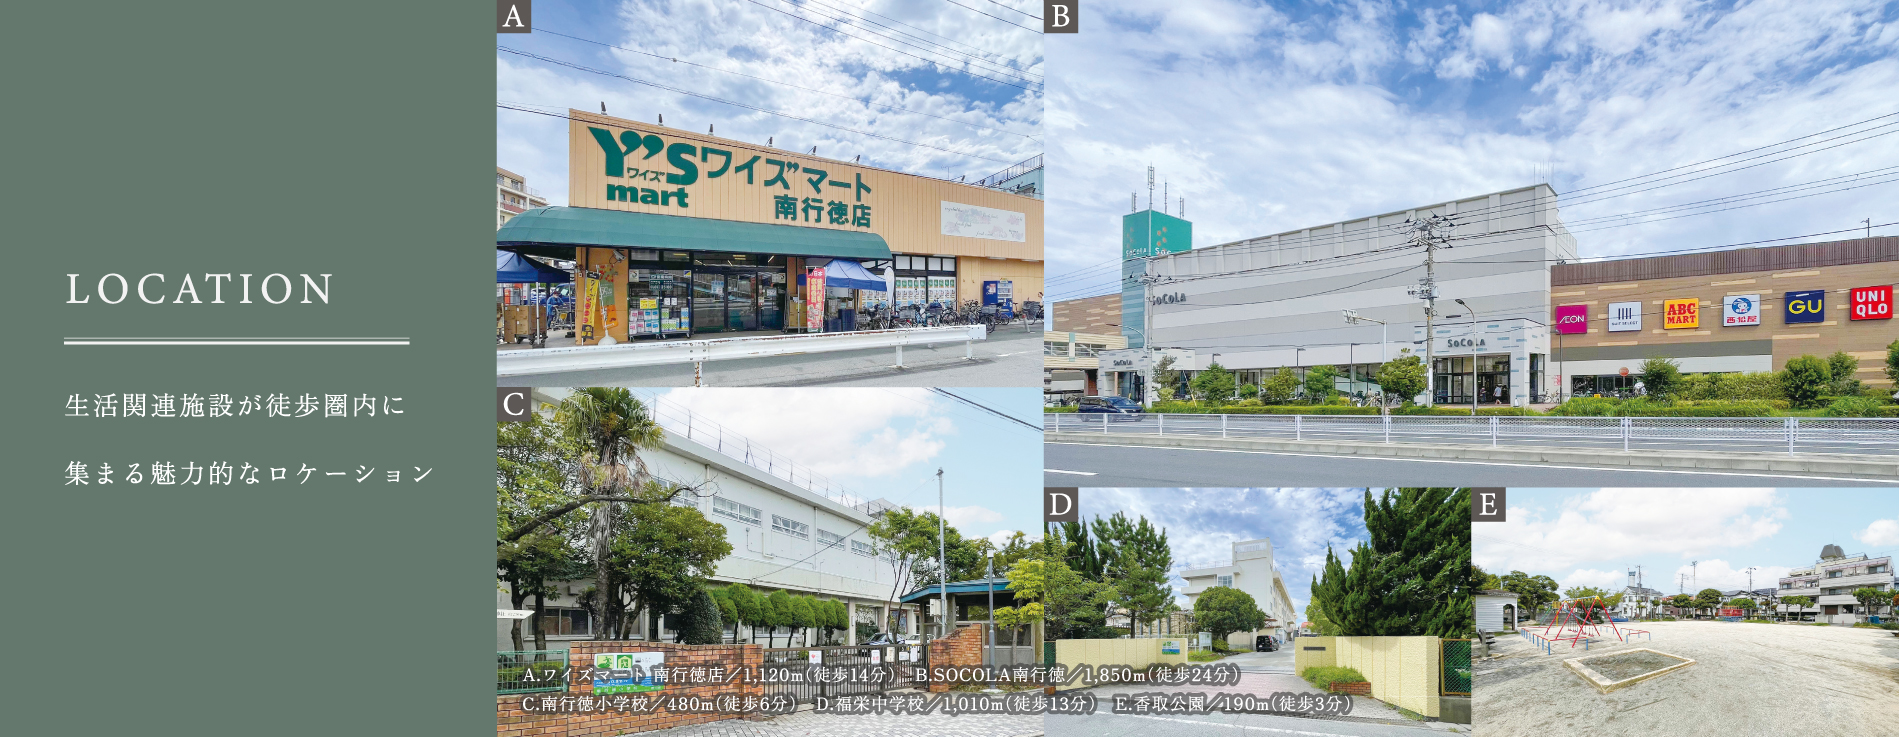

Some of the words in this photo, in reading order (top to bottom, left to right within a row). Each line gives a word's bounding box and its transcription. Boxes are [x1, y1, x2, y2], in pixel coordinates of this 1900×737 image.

[626, 166, 665, 183] ワイズ
[701, 145, 872, 202] ワイズマート
[606, 183, 689, 208] mart
[773, 193, 872, 229] 南行徳店
[1856, 290, 1885, 303] UNI
[1666, 302, 1697, 316] ABC
[1788, 299, 1822, 315] GU
[1856, 303, 1888, 317] QLO
[1666, 314, 1697, 325] MART
